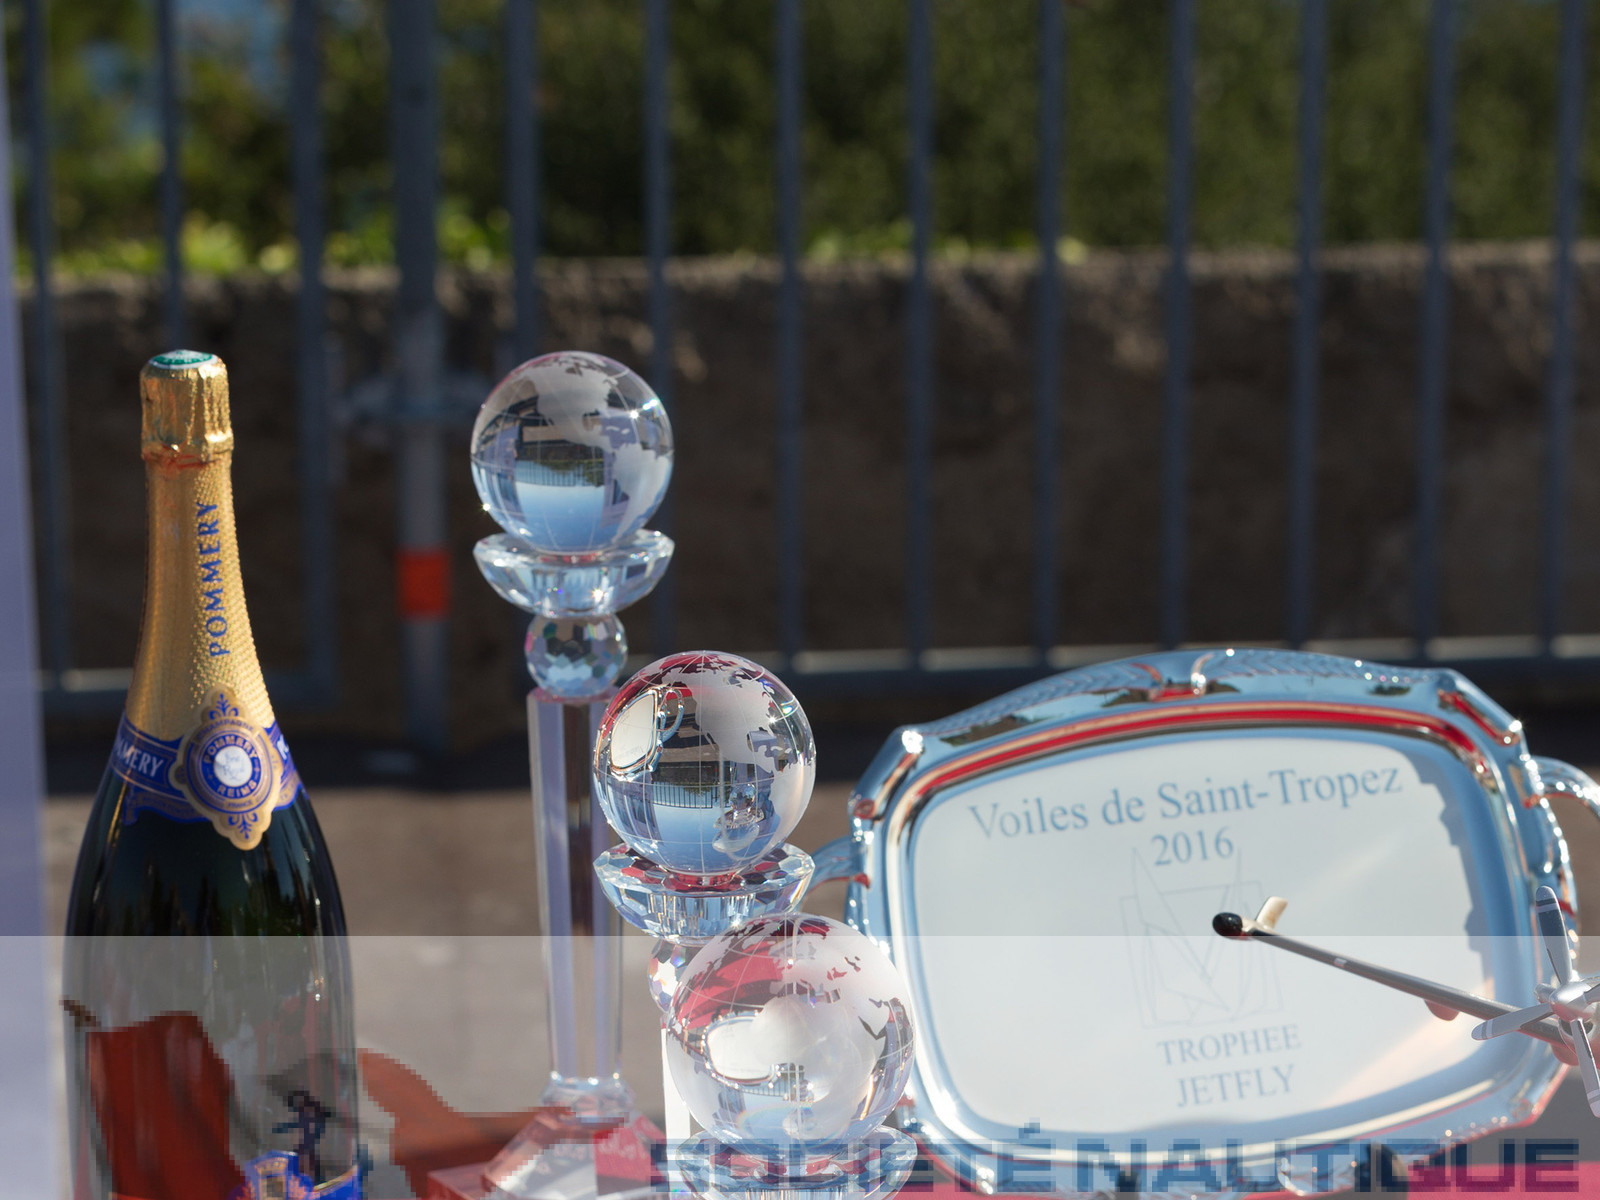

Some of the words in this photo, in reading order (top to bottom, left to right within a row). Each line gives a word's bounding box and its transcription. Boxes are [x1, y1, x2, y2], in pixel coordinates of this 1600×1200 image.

[196, 502, 230, 656] POMMERY
[203, 734, 258, 764] POMMERY
[969, 797, 1089, 839] Voiles
[1101, 788, 1145, 825] de
[1156, 766, 1404, 820] Saint-Tropez
[1151, 827, 1234, 866] 2016
[1156, 1024, 1302, 1065] TROPHEE
[1177, 1064, 1294, 1108] JETFLY
